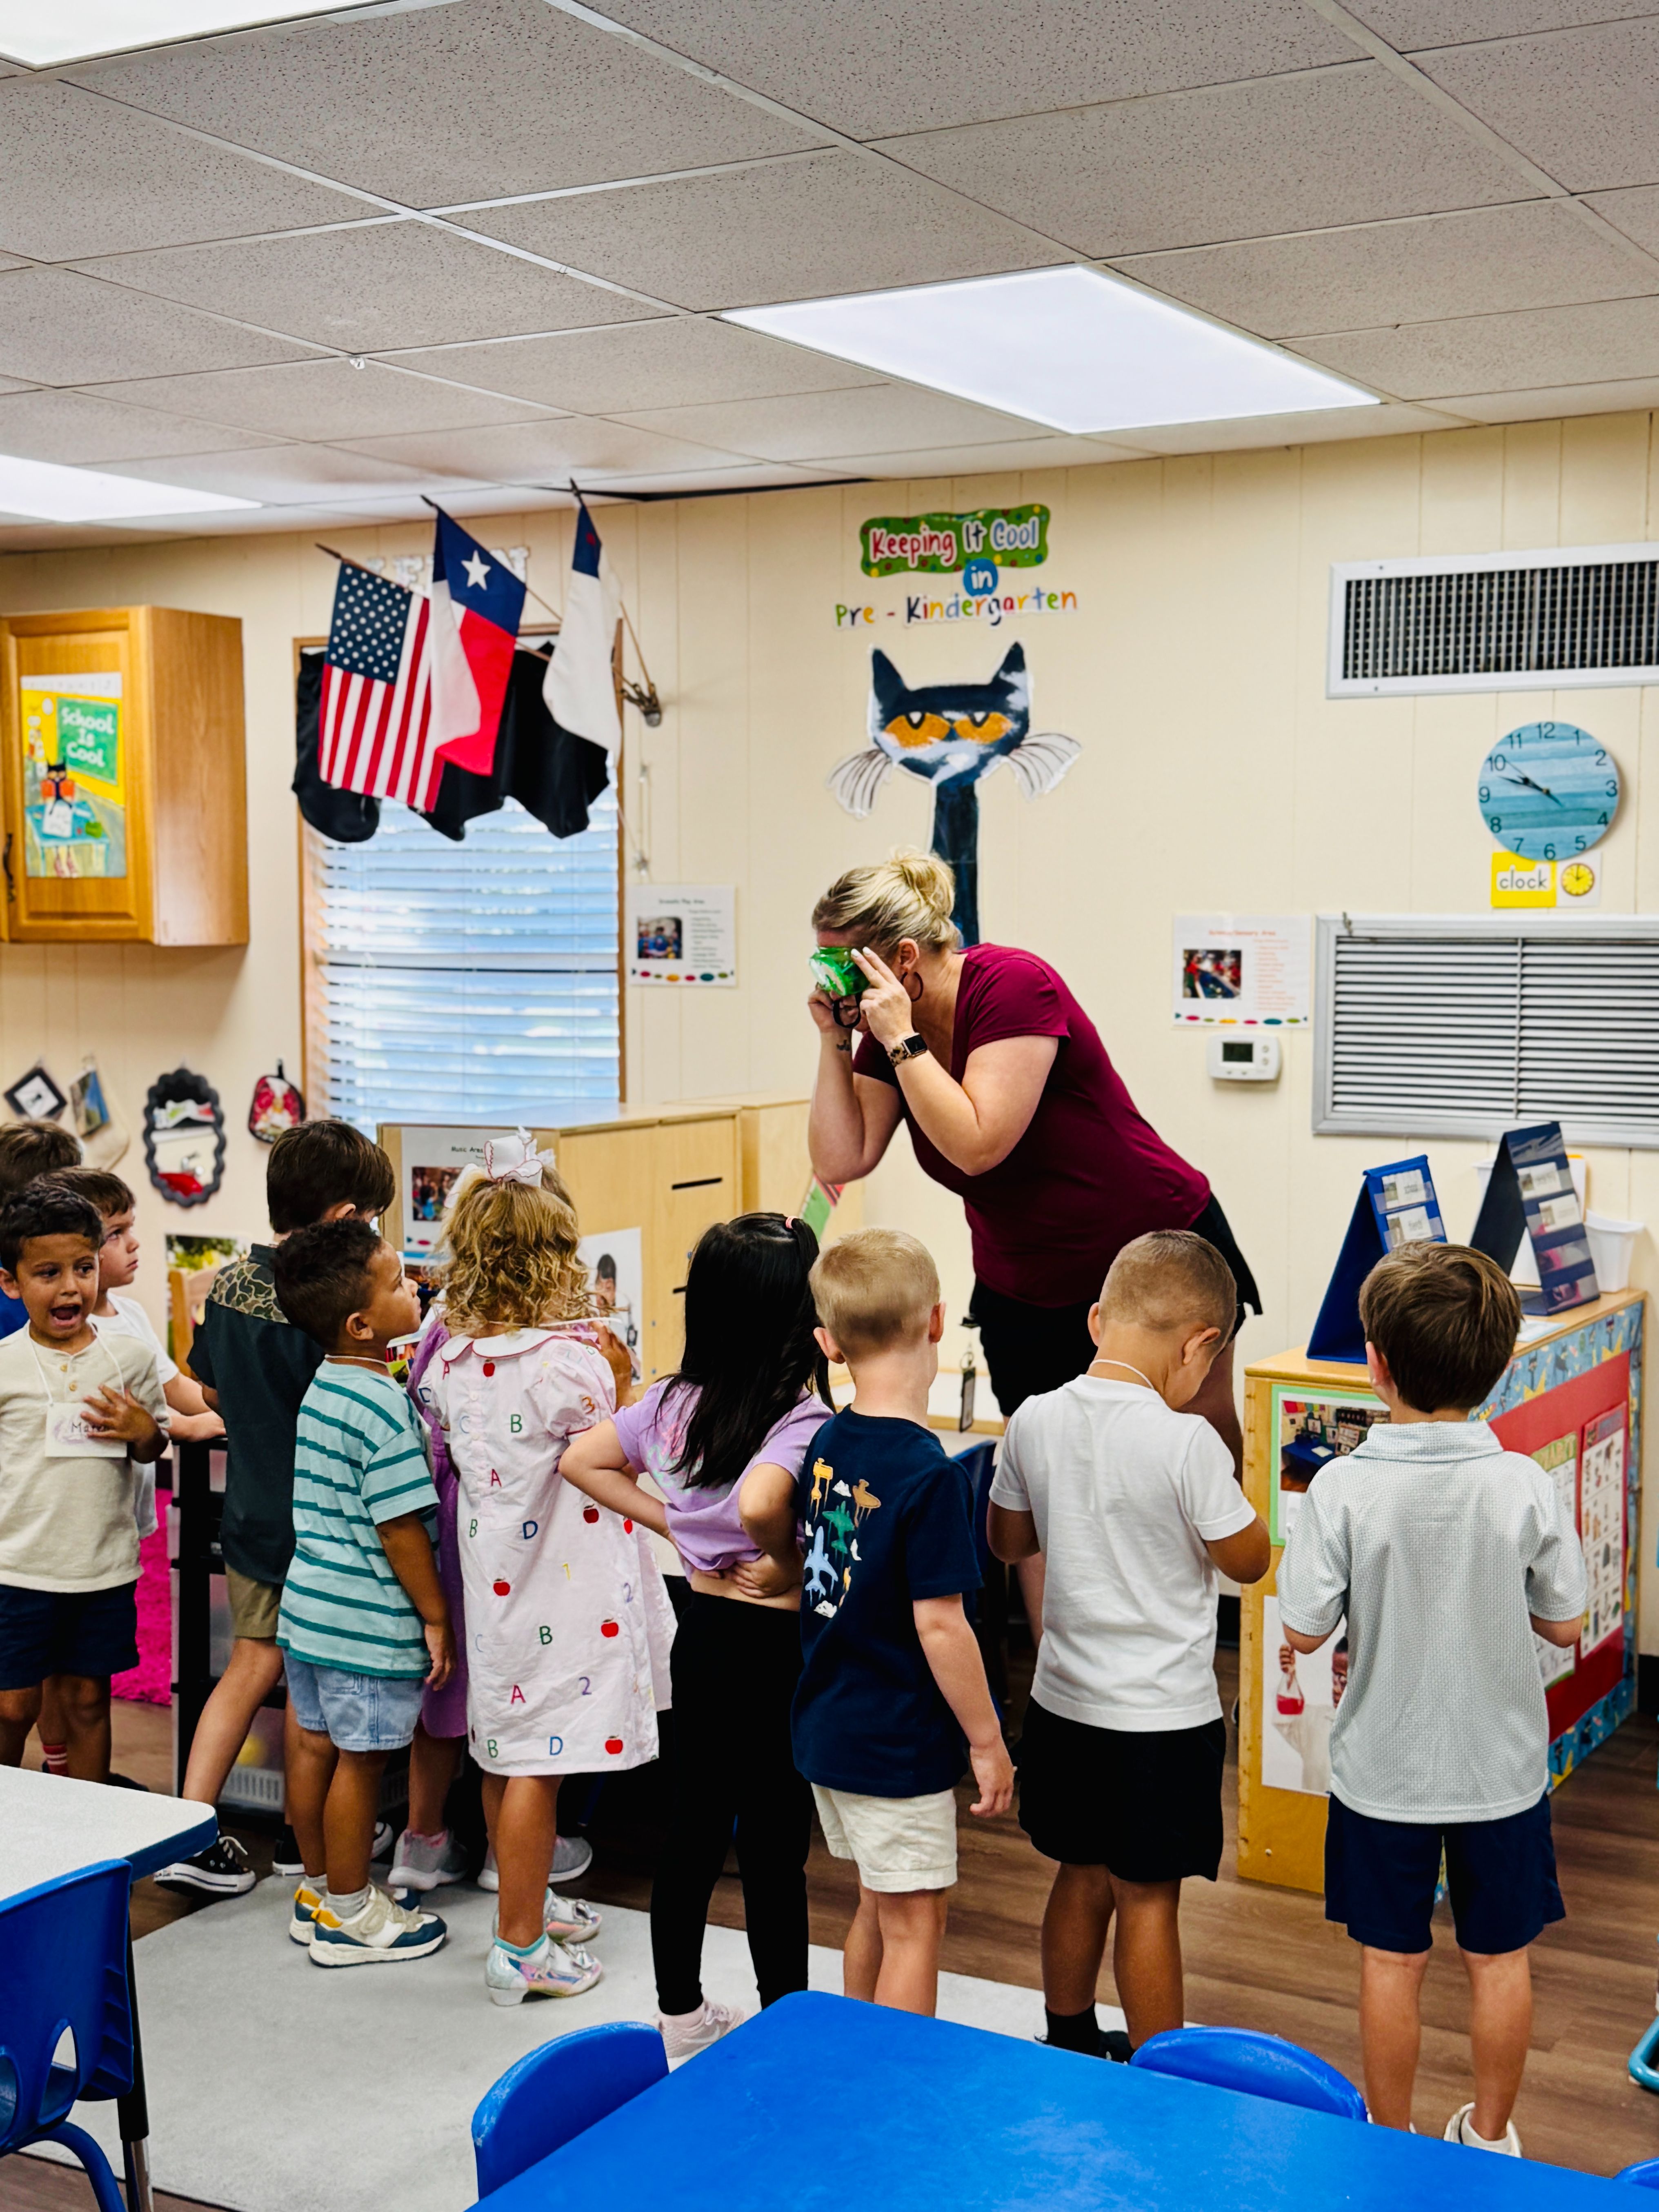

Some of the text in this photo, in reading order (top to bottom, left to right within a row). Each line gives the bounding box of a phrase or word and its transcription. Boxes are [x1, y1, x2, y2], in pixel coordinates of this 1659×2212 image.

[872, 519, 1037, 564] Keeping It Cool
[971, 567, 993, 589] in
[835, 604, 875, 626] Pre
[907, 588, 1077, 625] Kindergarten
[62, 707, 114, 734] School
[77, 728, 94, 747] Is
[1509, 733, 1522, 748] 11
[1536, 723, 1556, 739] 12
[1573, 729, 1580, 745] 1
[66, 742, 105, 767] Cool
[1487, 754, 1506, 771] 10
[1595, 749, 1607, 766] 2
[1479, 787, 1490, 803] 9
[1606, 780, 1618, 797] 3
[1490, 817, 1502, 833] 8
[1597, 811, 1609, 827] 4
[1513, 838, 1524, 852] 7
[1543, 843, 1556, 860] 6
[1575, 835, 1586, 851] 5
[1499, 869, 1548, 889] clock
[581, 1396, 596, 1415] 3
[459, 1415, 470, 1434] C
[510, 1414, 523, 1433] B
[490, 1469, 502, 1487] A
[469, 1518, 478, 1538] B
[523, 1520, 538, 1539] D
[562, 1563, 571, 1581] 1
[623, 1582, 634, 1603] 2
[475, 1634, 484, 1653] C
[539, 1626, 553, 1645] B
[511, 1685, 526, 1705] A
[579, 1676, 592, 1696] 2
[487, 1739, 498, 1758] B
[549, 1736, 563, 1755] D
